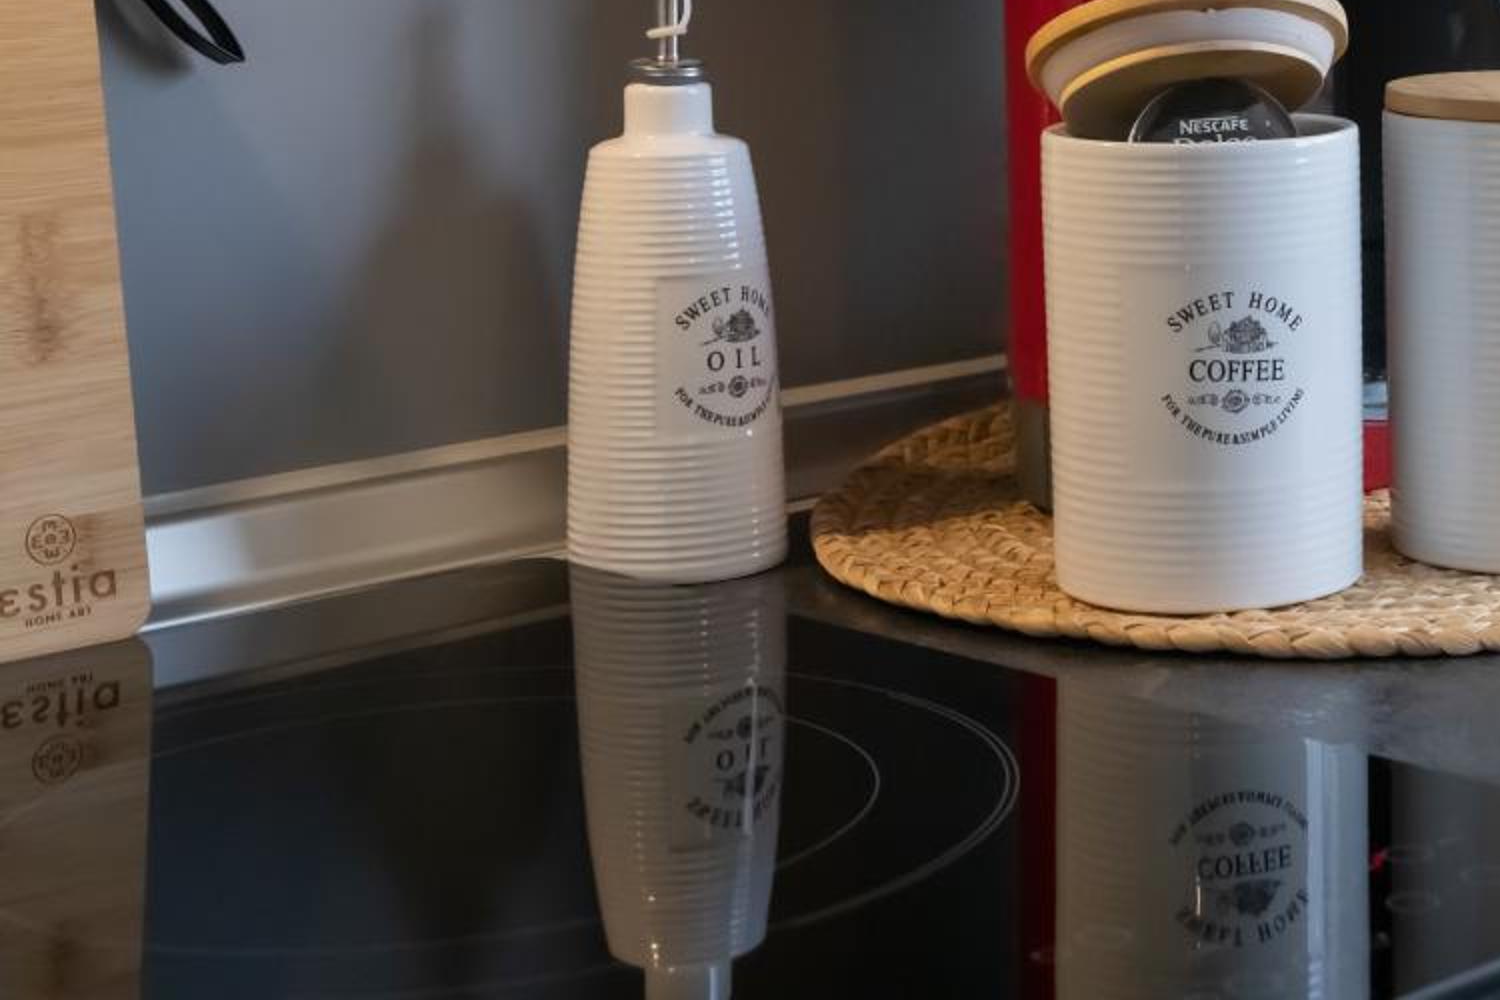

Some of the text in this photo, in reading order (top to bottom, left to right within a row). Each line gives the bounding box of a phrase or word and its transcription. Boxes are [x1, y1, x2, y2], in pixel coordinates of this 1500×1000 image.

[675, 287, 731, 331] SWEET
[1167, 292, 1303, 333] SWEET HOME
[707, 346, 761, 371] OIL
[1189, 359, 1285, 382] COFFEE
[1161, 393, 1181, 418] FOR
